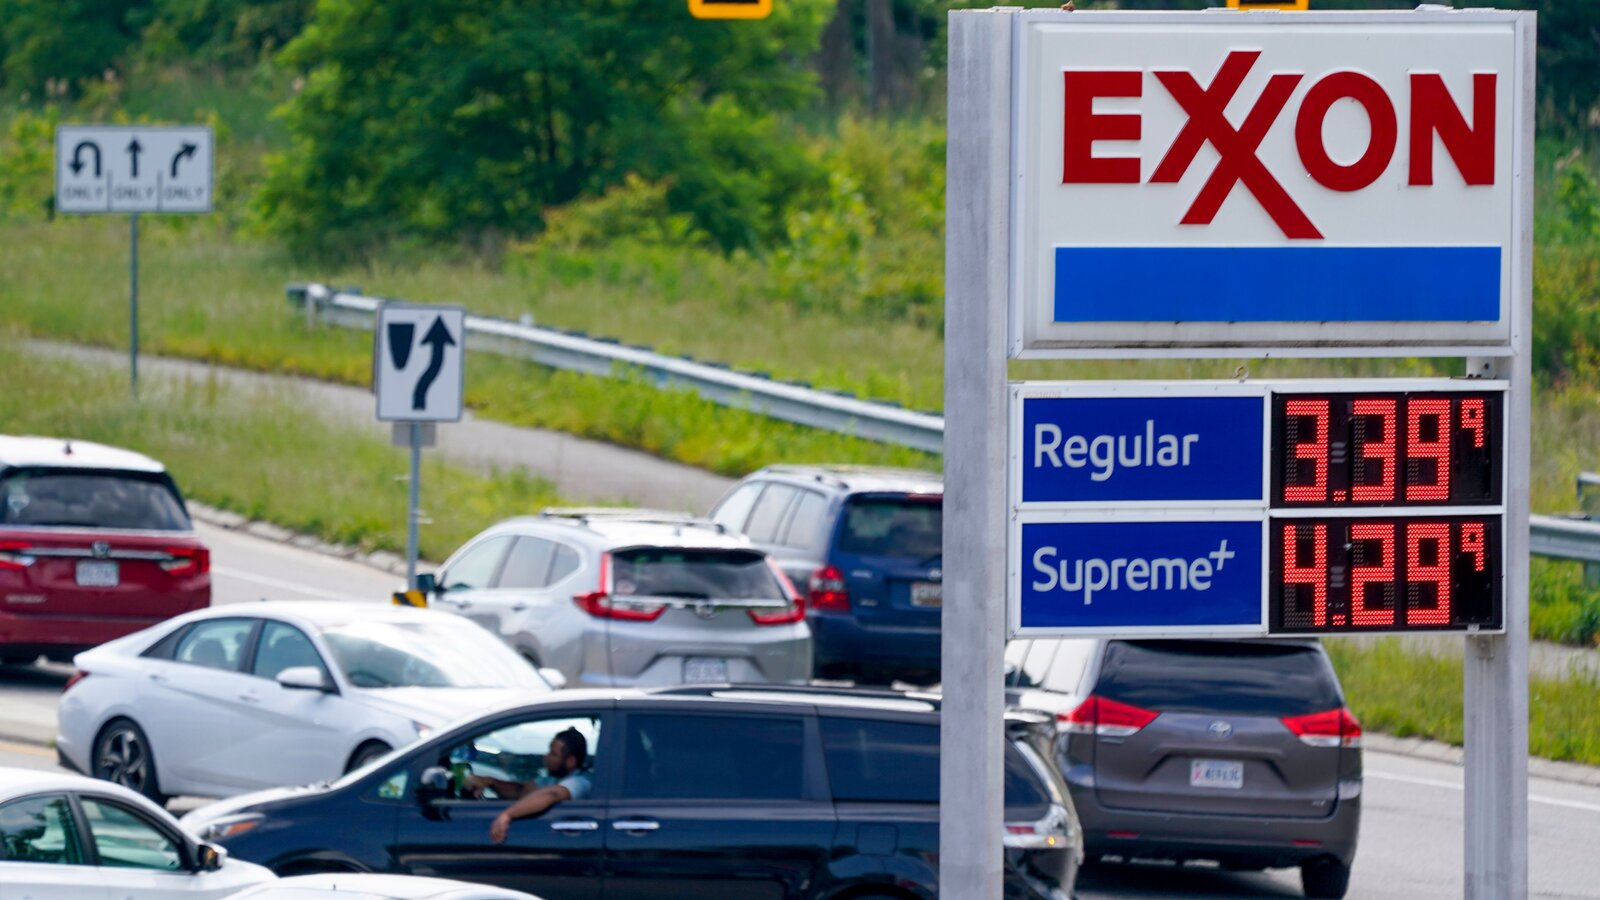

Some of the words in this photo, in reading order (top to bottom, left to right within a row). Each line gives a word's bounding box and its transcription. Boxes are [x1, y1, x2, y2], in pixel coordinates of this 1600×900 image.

[1062, 51, 1498, 239] EXXON
[64, 186, 104, 199] ONLY
[113, 186, 154, 199] ONLY
[165, 186, 205, 199] ONLY
[1034, 419, 1200, 482] Regular
